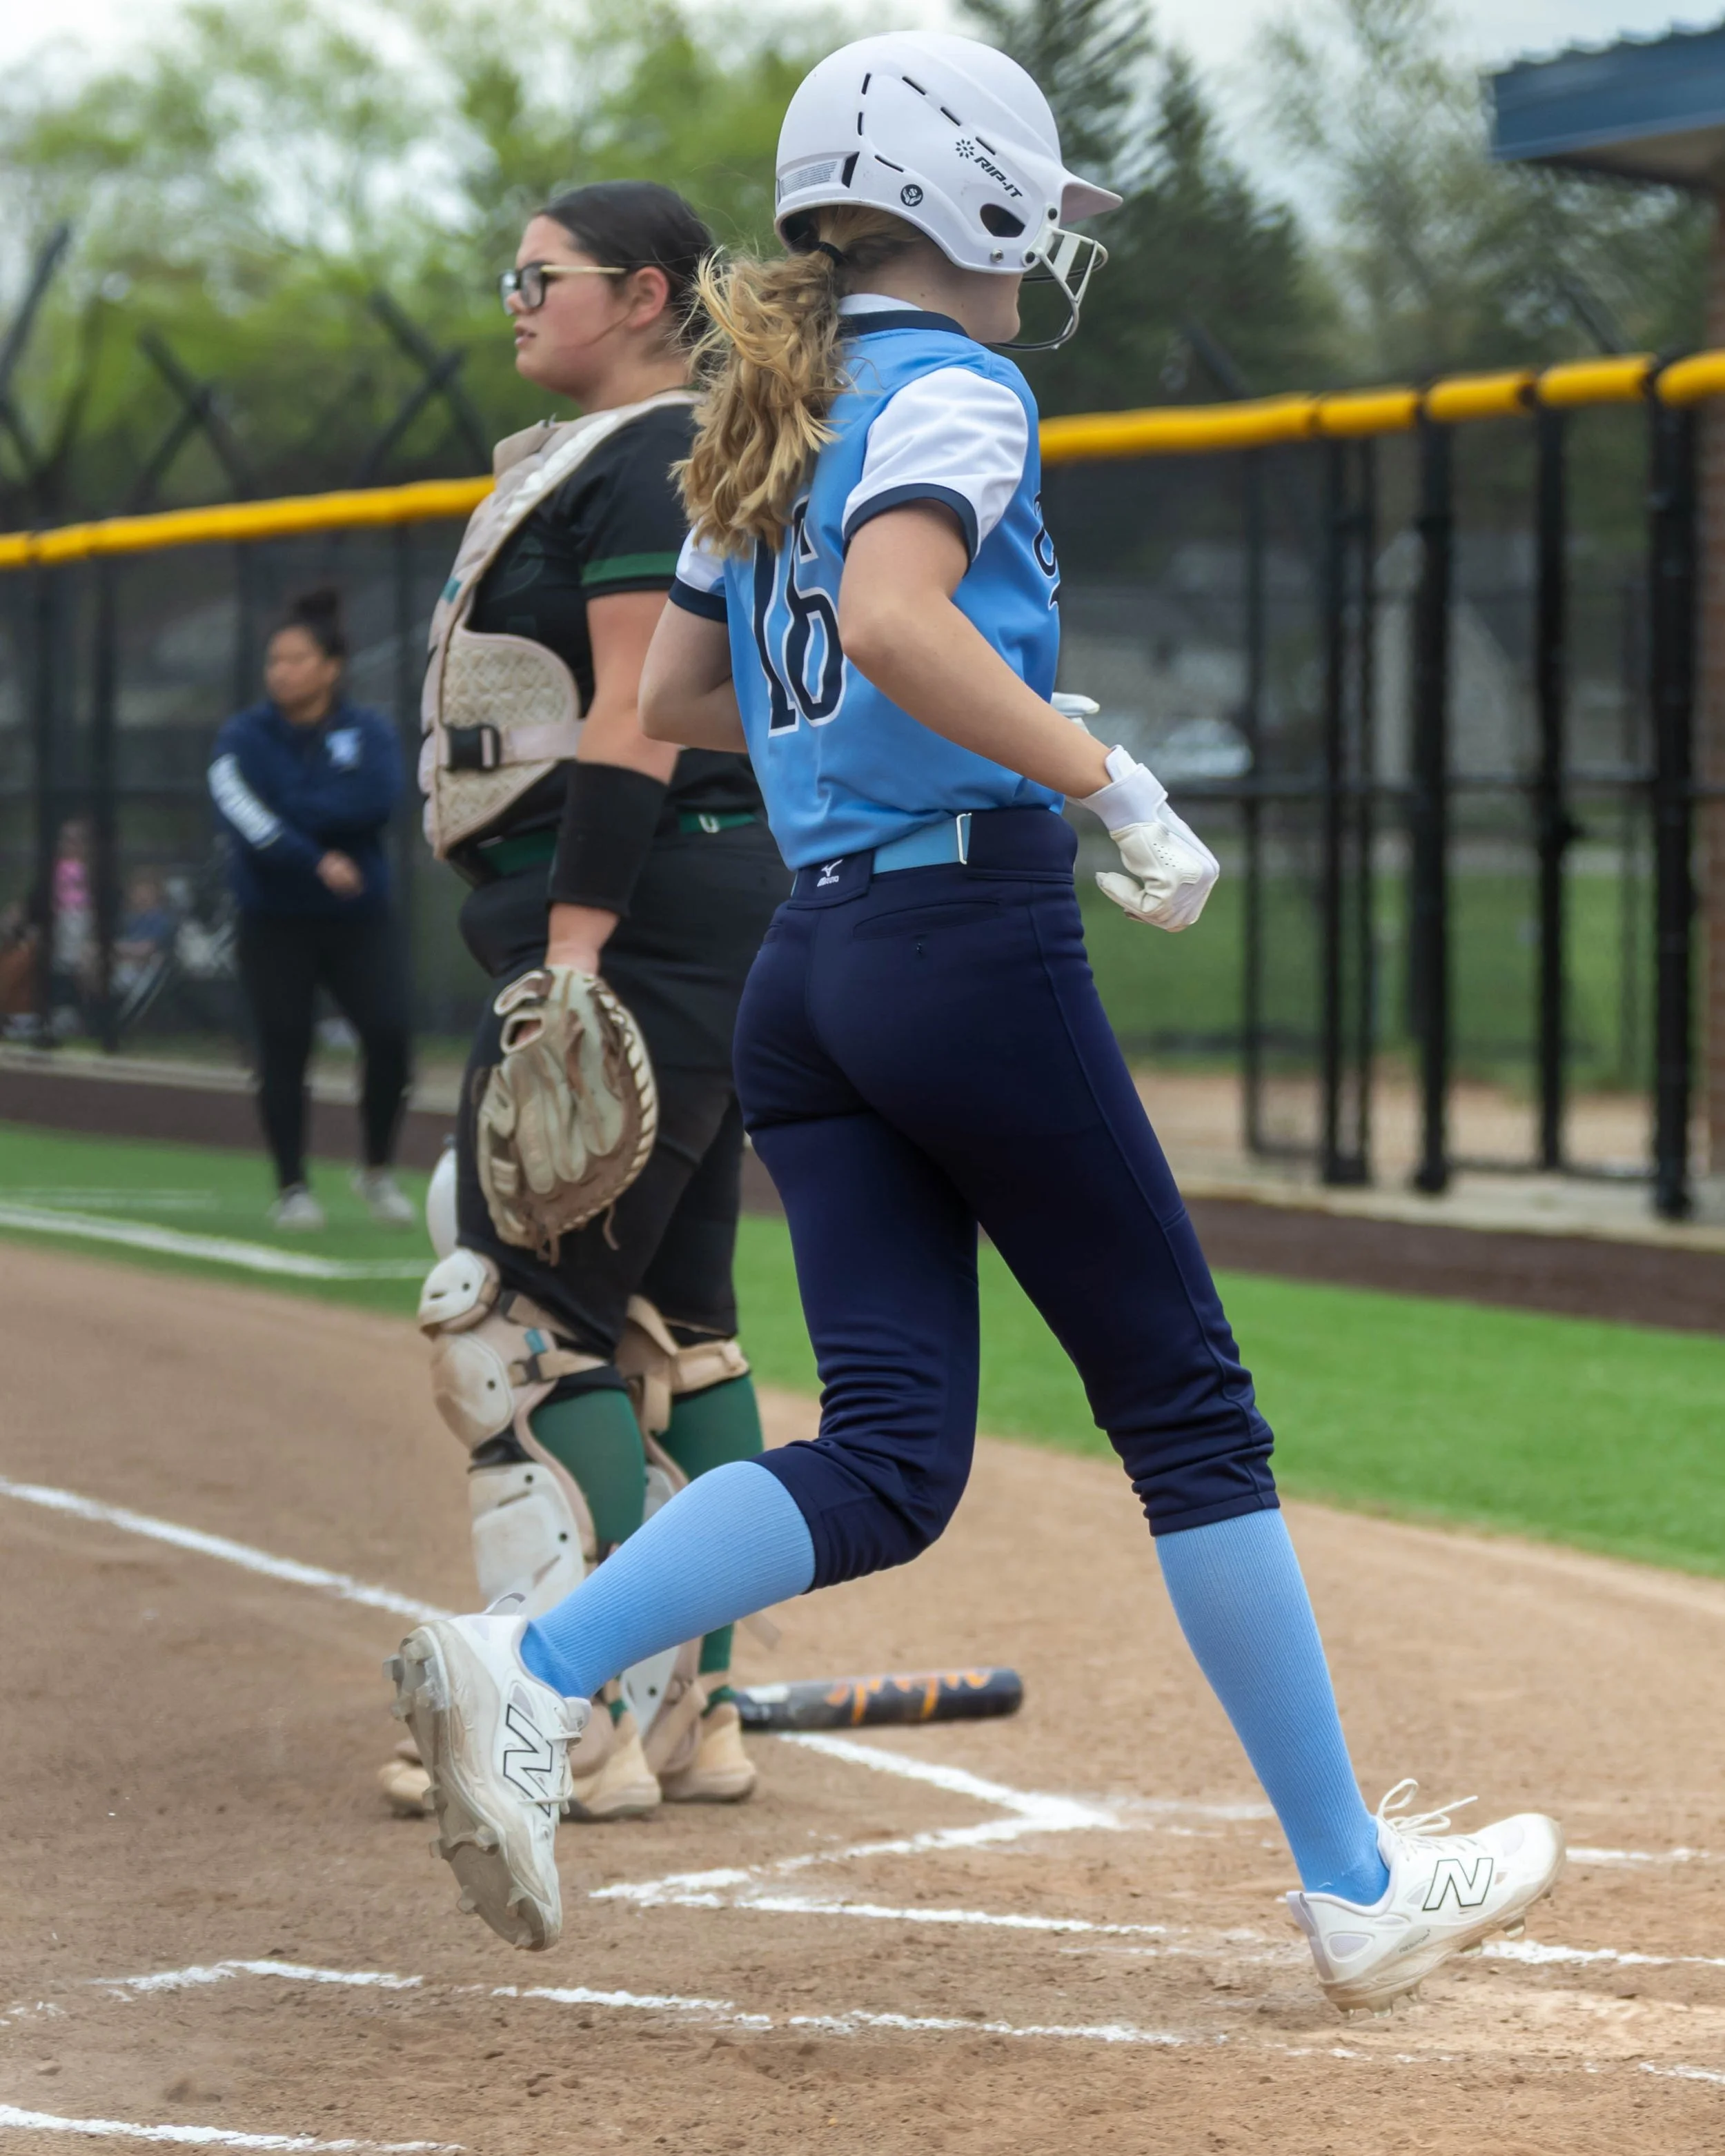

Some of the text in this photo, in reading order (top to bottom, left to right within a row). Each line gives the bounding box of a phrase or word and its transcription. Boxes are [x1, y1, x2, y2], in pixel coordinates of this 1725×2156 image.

[974, 156, 1023, 197] RIP-IT
[753, 495, 847, 738] 16
[1421, 1857, 1494, 1911] N
